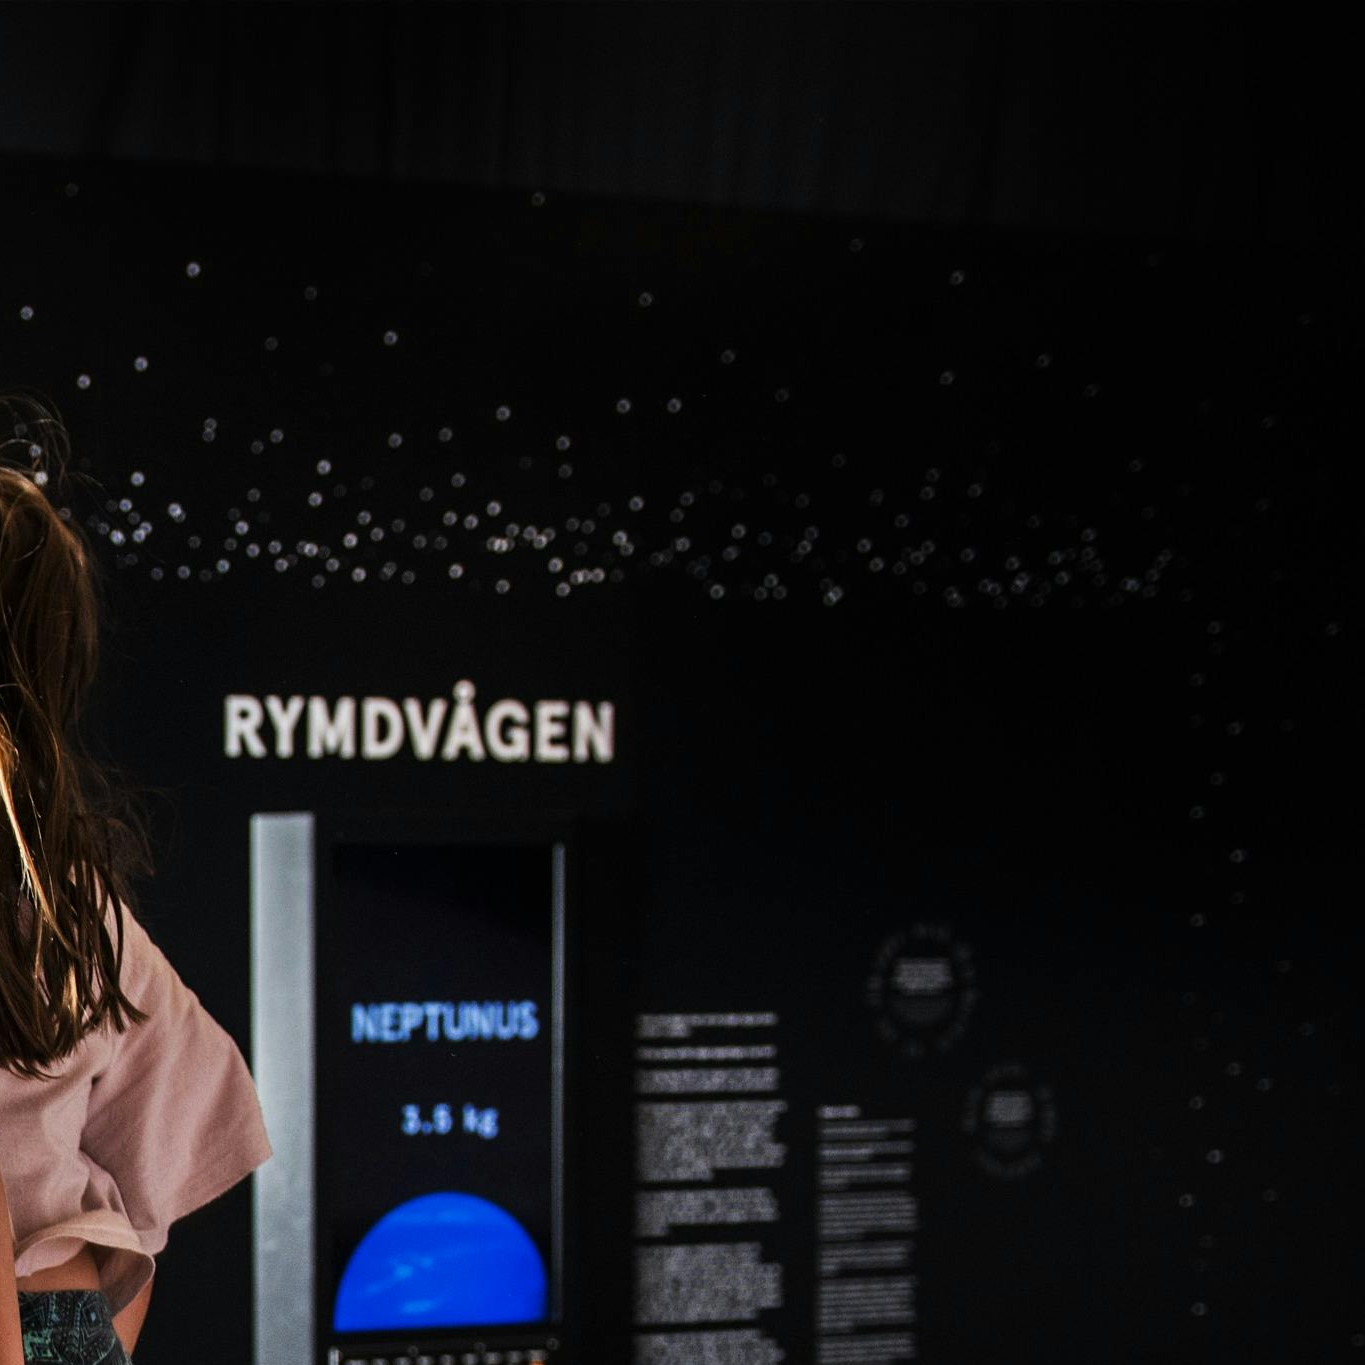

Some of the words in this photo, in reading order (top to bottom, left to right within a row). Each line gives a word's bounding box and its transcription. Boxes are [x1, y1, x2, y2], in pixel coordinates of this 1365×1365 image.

[224, 679, 615, 763] RYMDVÅGEN
[351, 1000, 539, 1043] NEPTUNUS
[462, 1103, 498, 1139] kg
